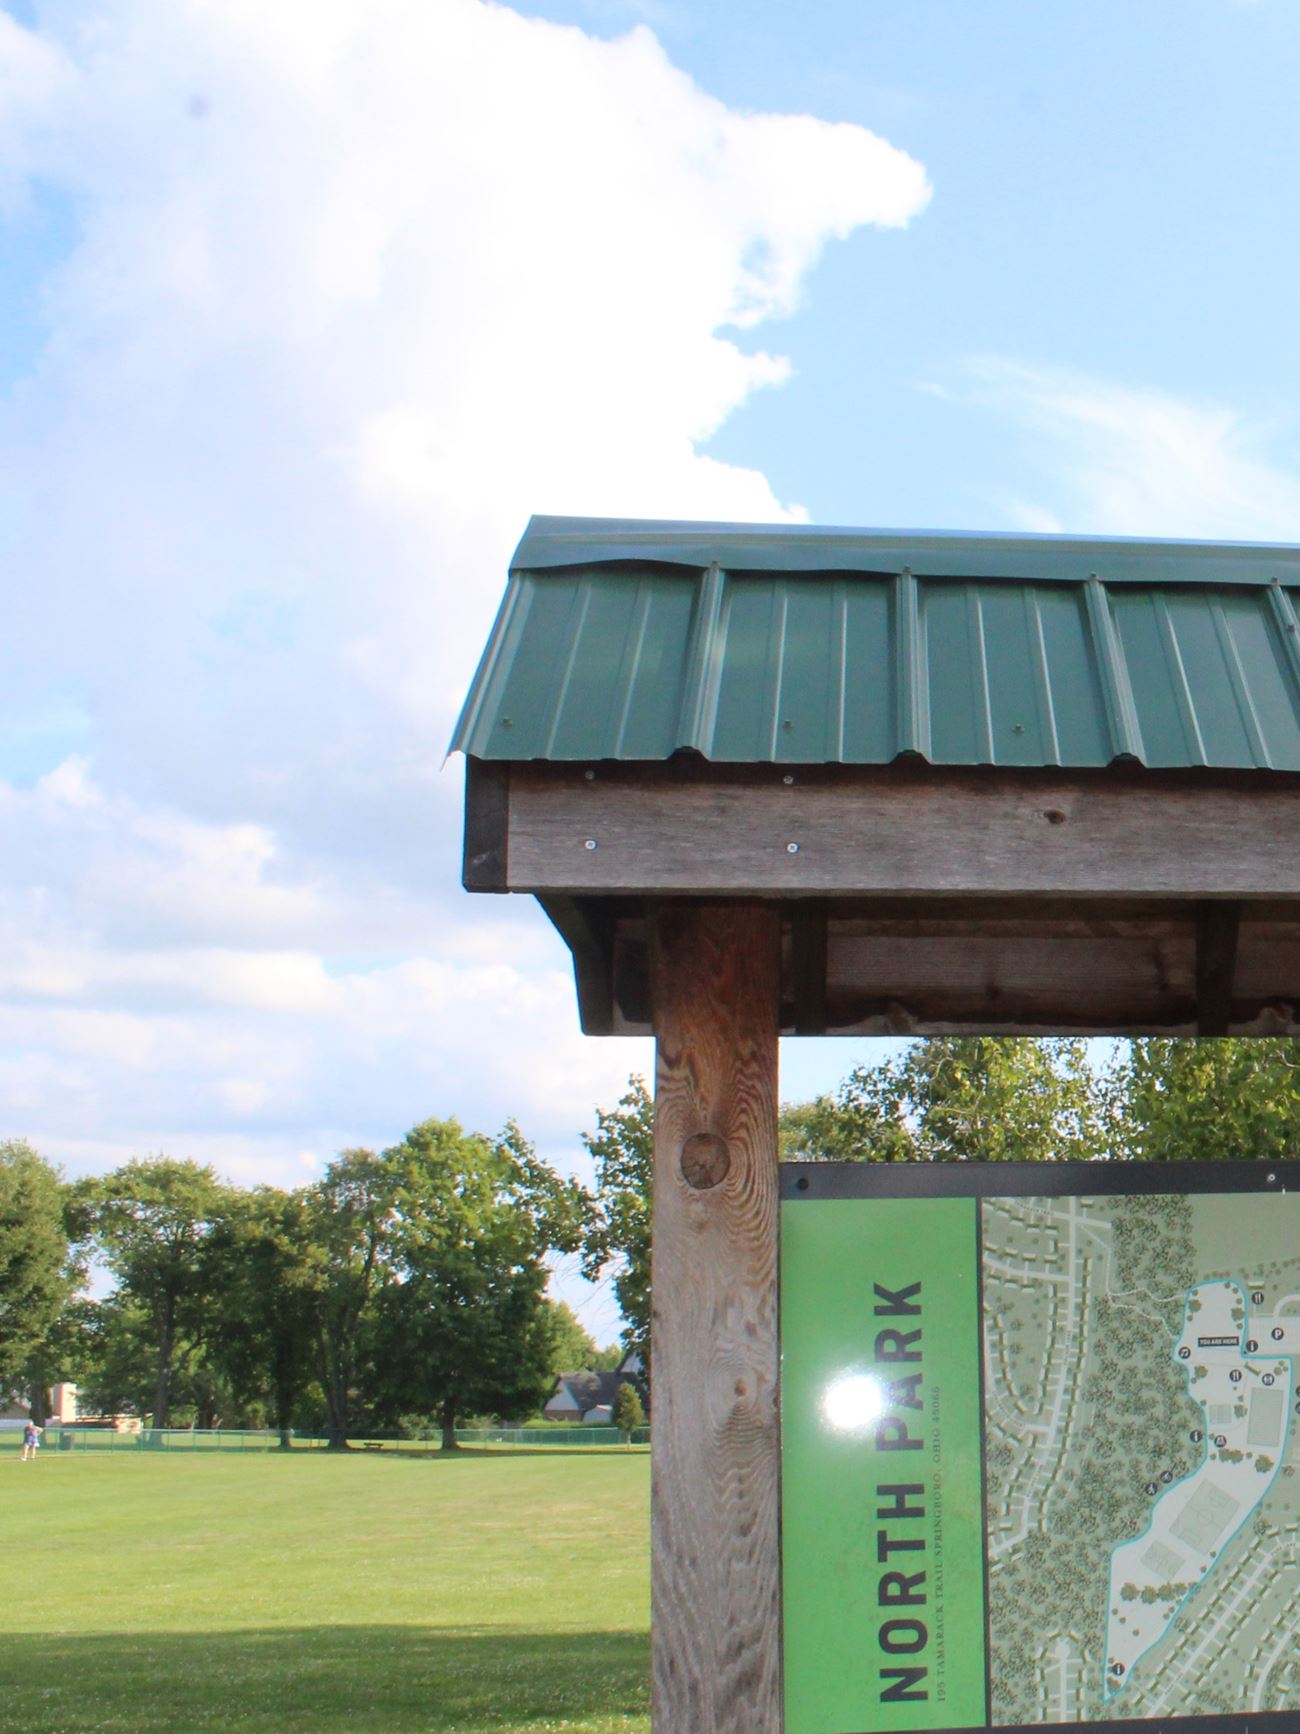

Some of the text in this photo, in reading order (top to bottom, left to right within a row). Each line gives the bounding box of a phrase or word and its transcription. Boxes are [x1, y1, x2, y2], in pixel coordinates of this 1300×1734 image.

[932, 1427, 942, 1463] OHIO
[873, 1280, 929, 1703] NORTH PARK
[934, 1562, 944, 1599] TRAIL
[935, 1604, 945, 1675] TAMARACK
[937, 1681, 946, 1702] 195
